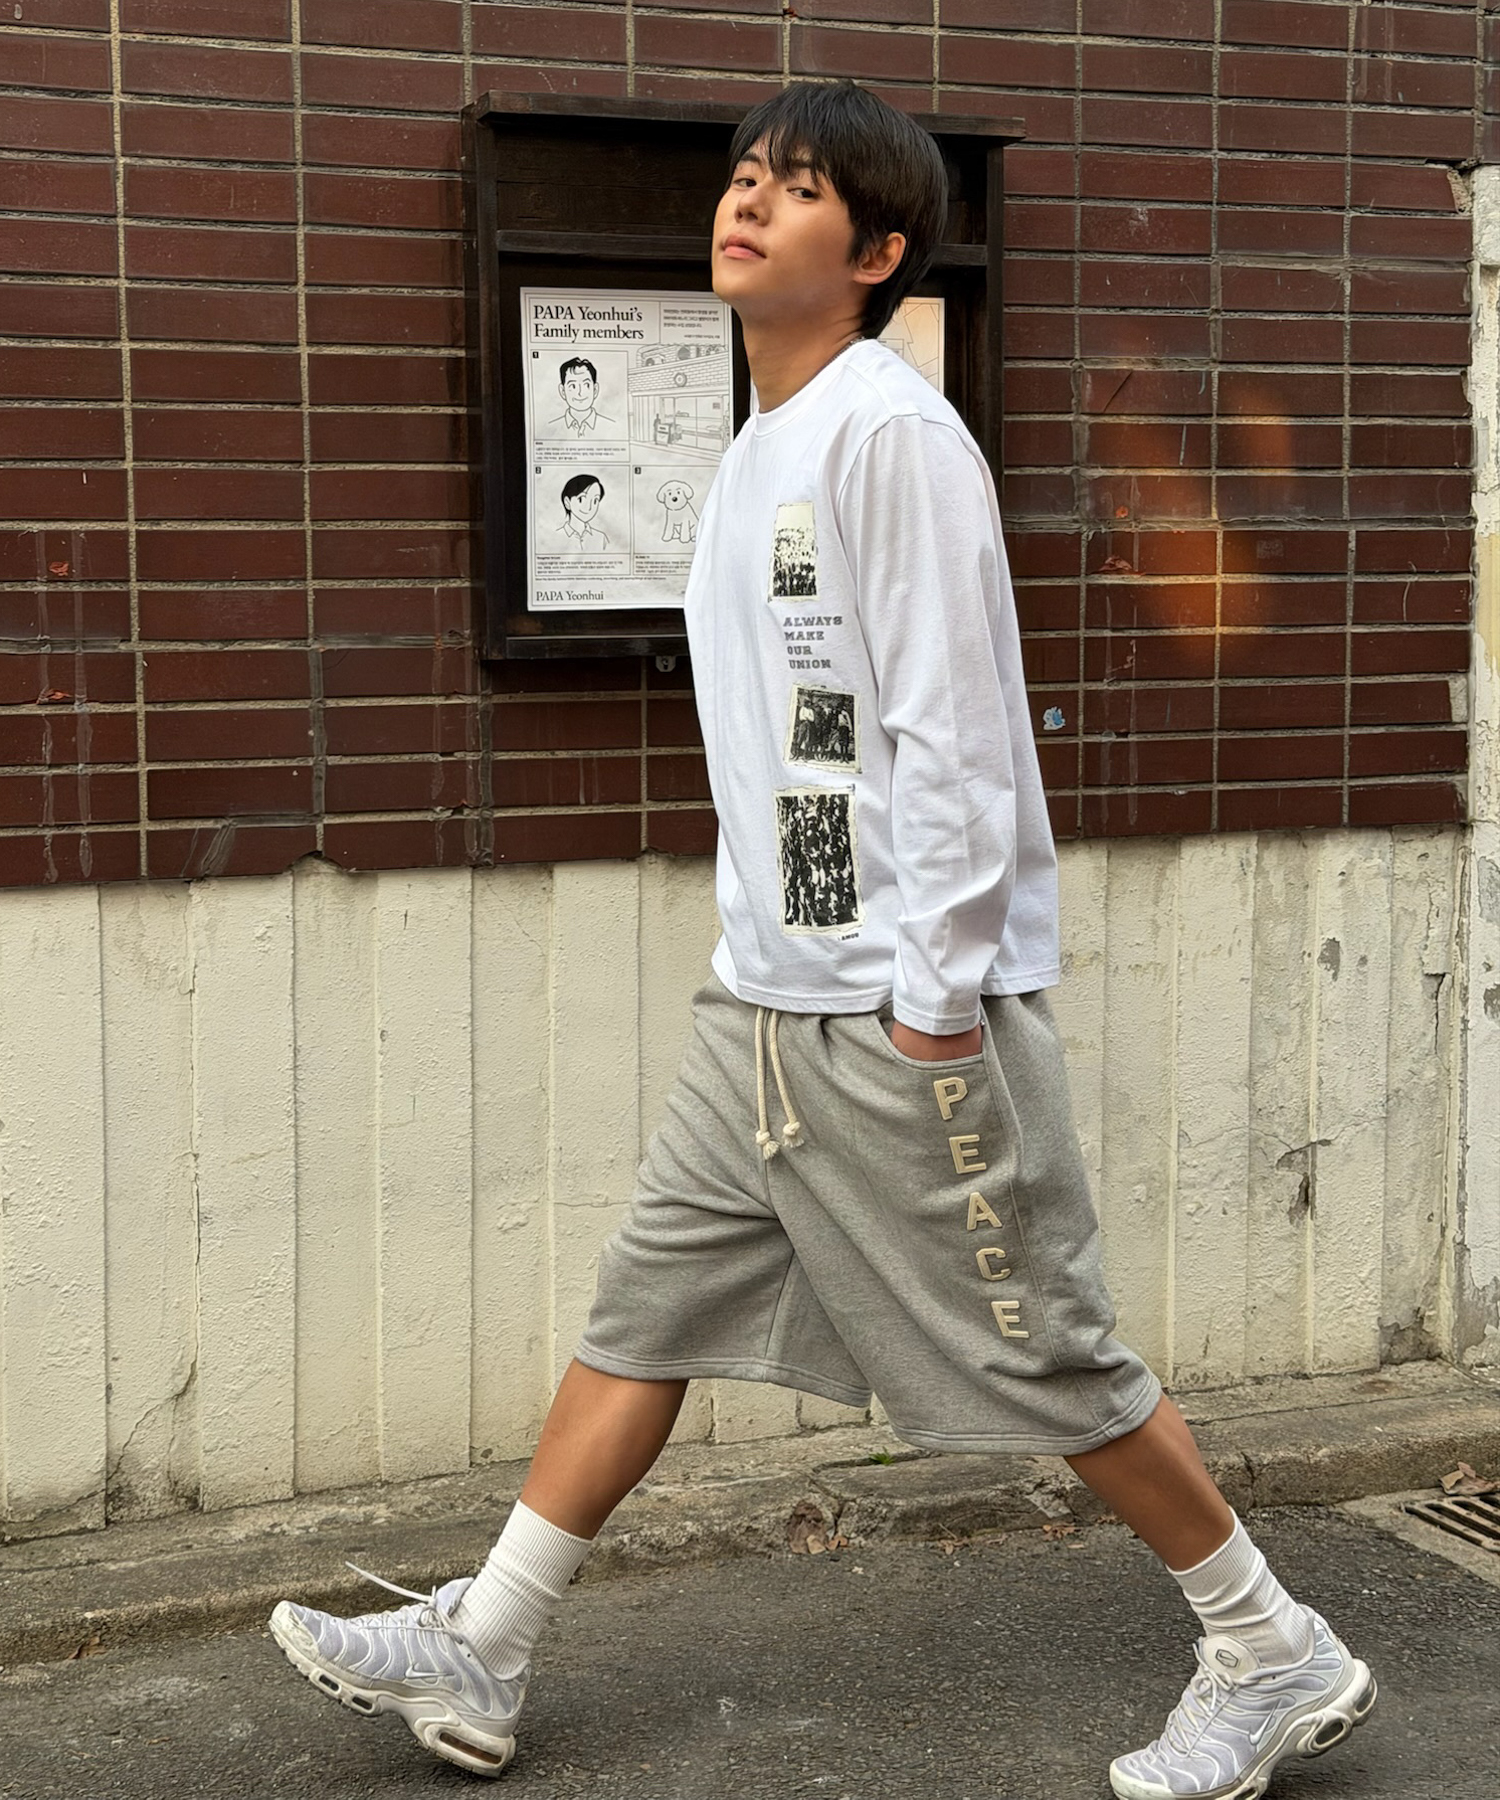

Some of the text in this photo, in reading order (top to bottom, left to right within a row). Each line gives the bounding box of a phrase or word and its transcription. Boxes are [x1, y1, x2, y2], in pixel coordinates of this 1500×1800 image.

[533, 305, 643, 321] PAPA Yeonhui’s
[534, 323, 644, 343] Family members
[536, 590, 604, 601] PAPA Yeonhui
[783, 616, 843, 627] ALWAYS
[784, 631, 825, 641] MAKE
[787, 645, 813, 656] OUR
[788, 659, 832, 670] UNION
[933, 1076, 1030, 1339] PEACE
